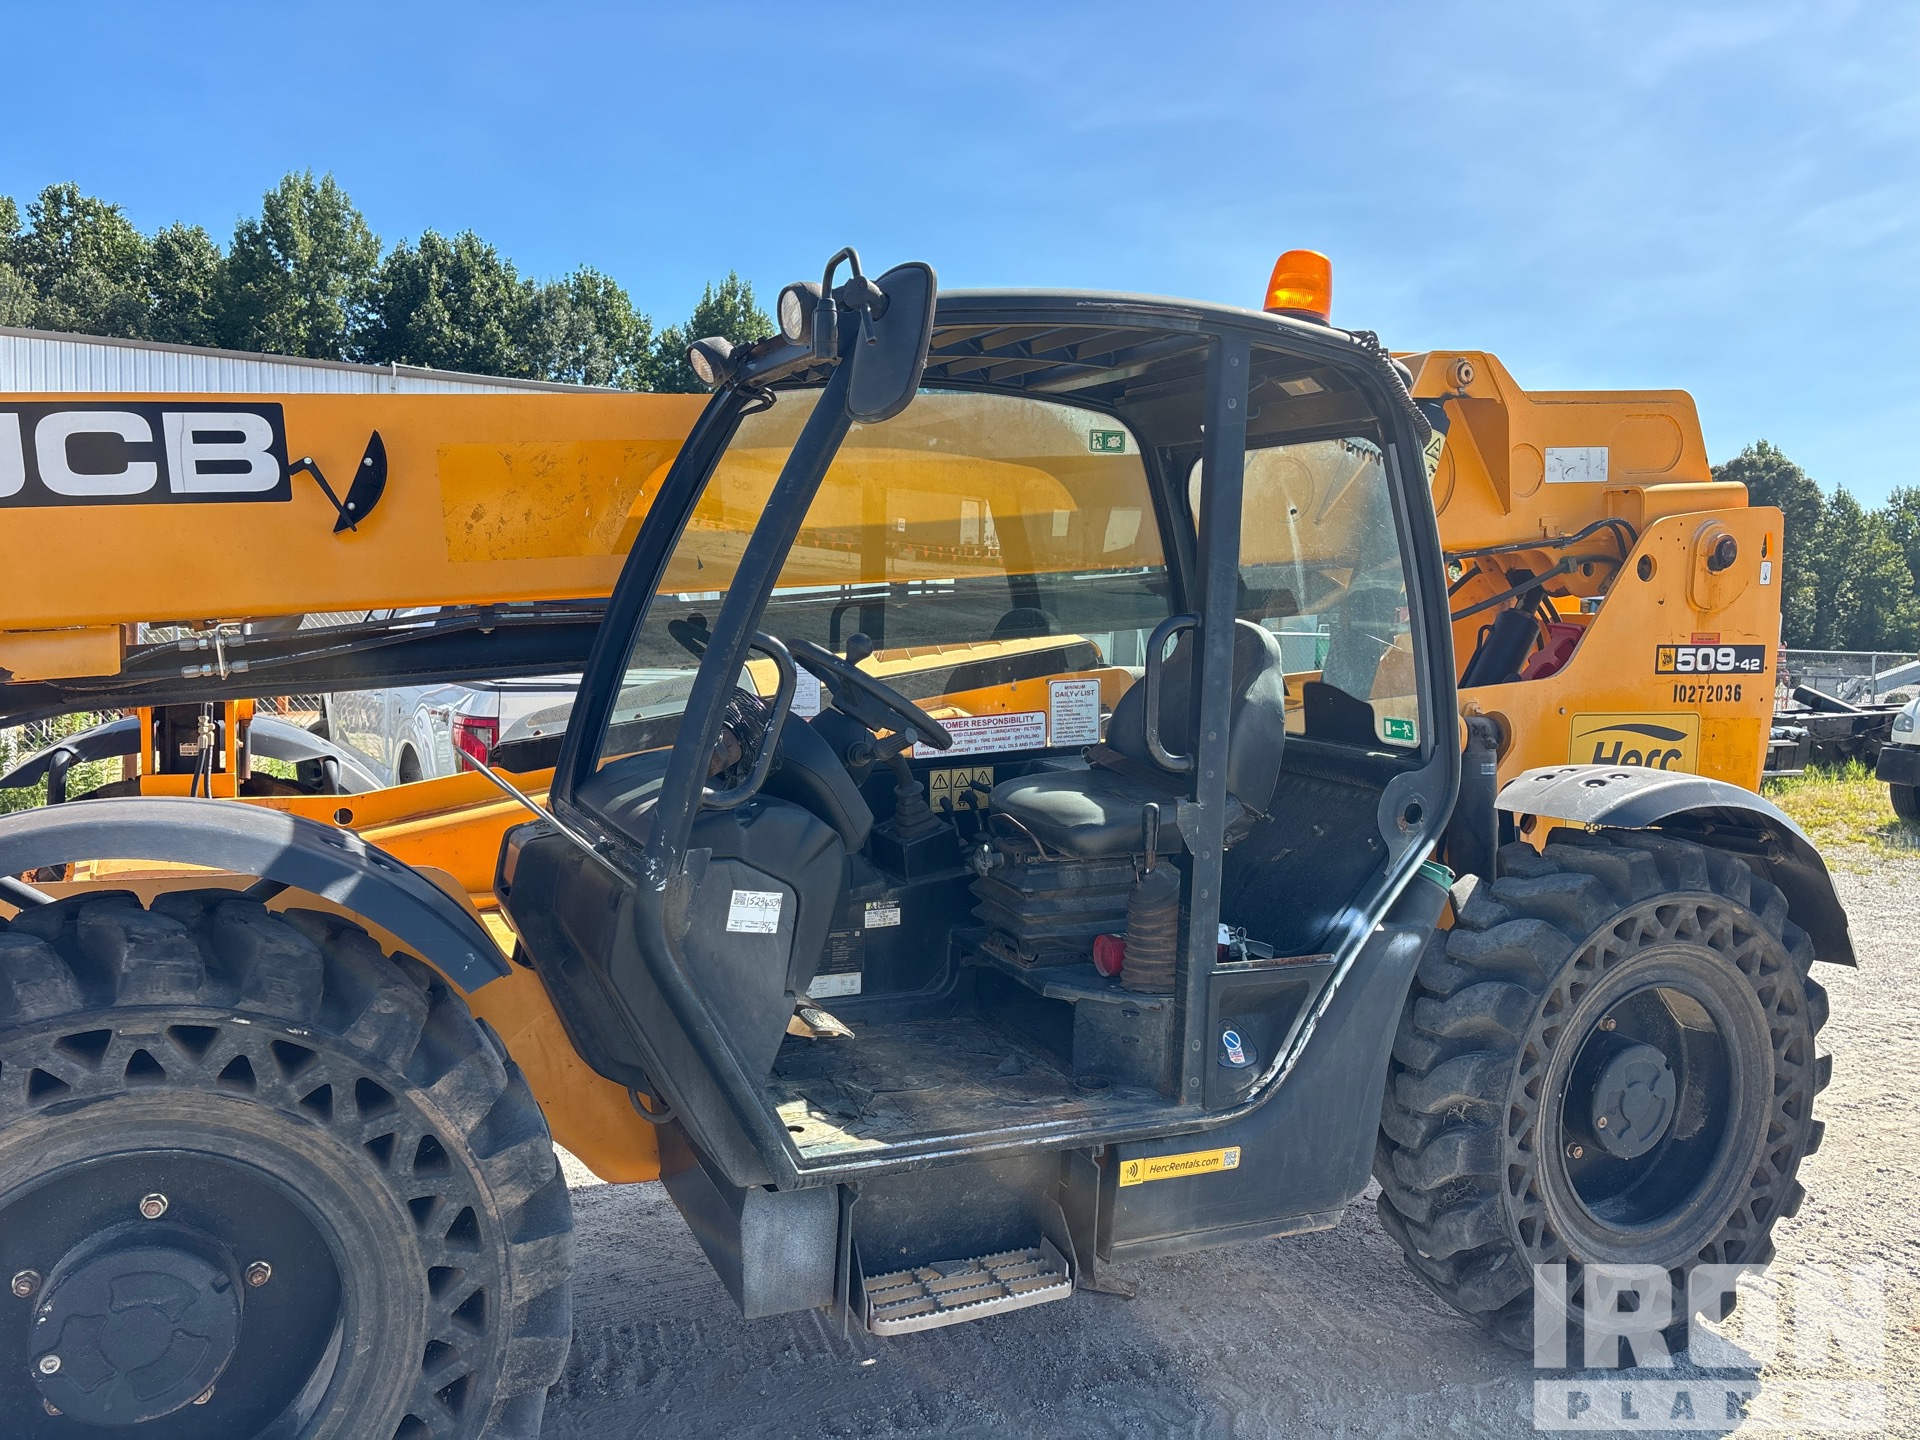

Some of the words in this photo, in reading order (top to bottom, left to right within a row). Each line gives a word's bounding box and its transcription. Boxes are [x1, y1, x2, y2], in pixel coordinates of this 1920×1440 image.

[1676, 648, 1760, 671] 509-42
[1055, 690, 1074, 698] DAILY
[1673, 684, 1742, 703] 10272036
[941, 720, 969, 729] TOMER
[971, 715, 1035, 727] RESPONSIBILITY
[1149, 1157, 1219, 1173] HercRentals.com
